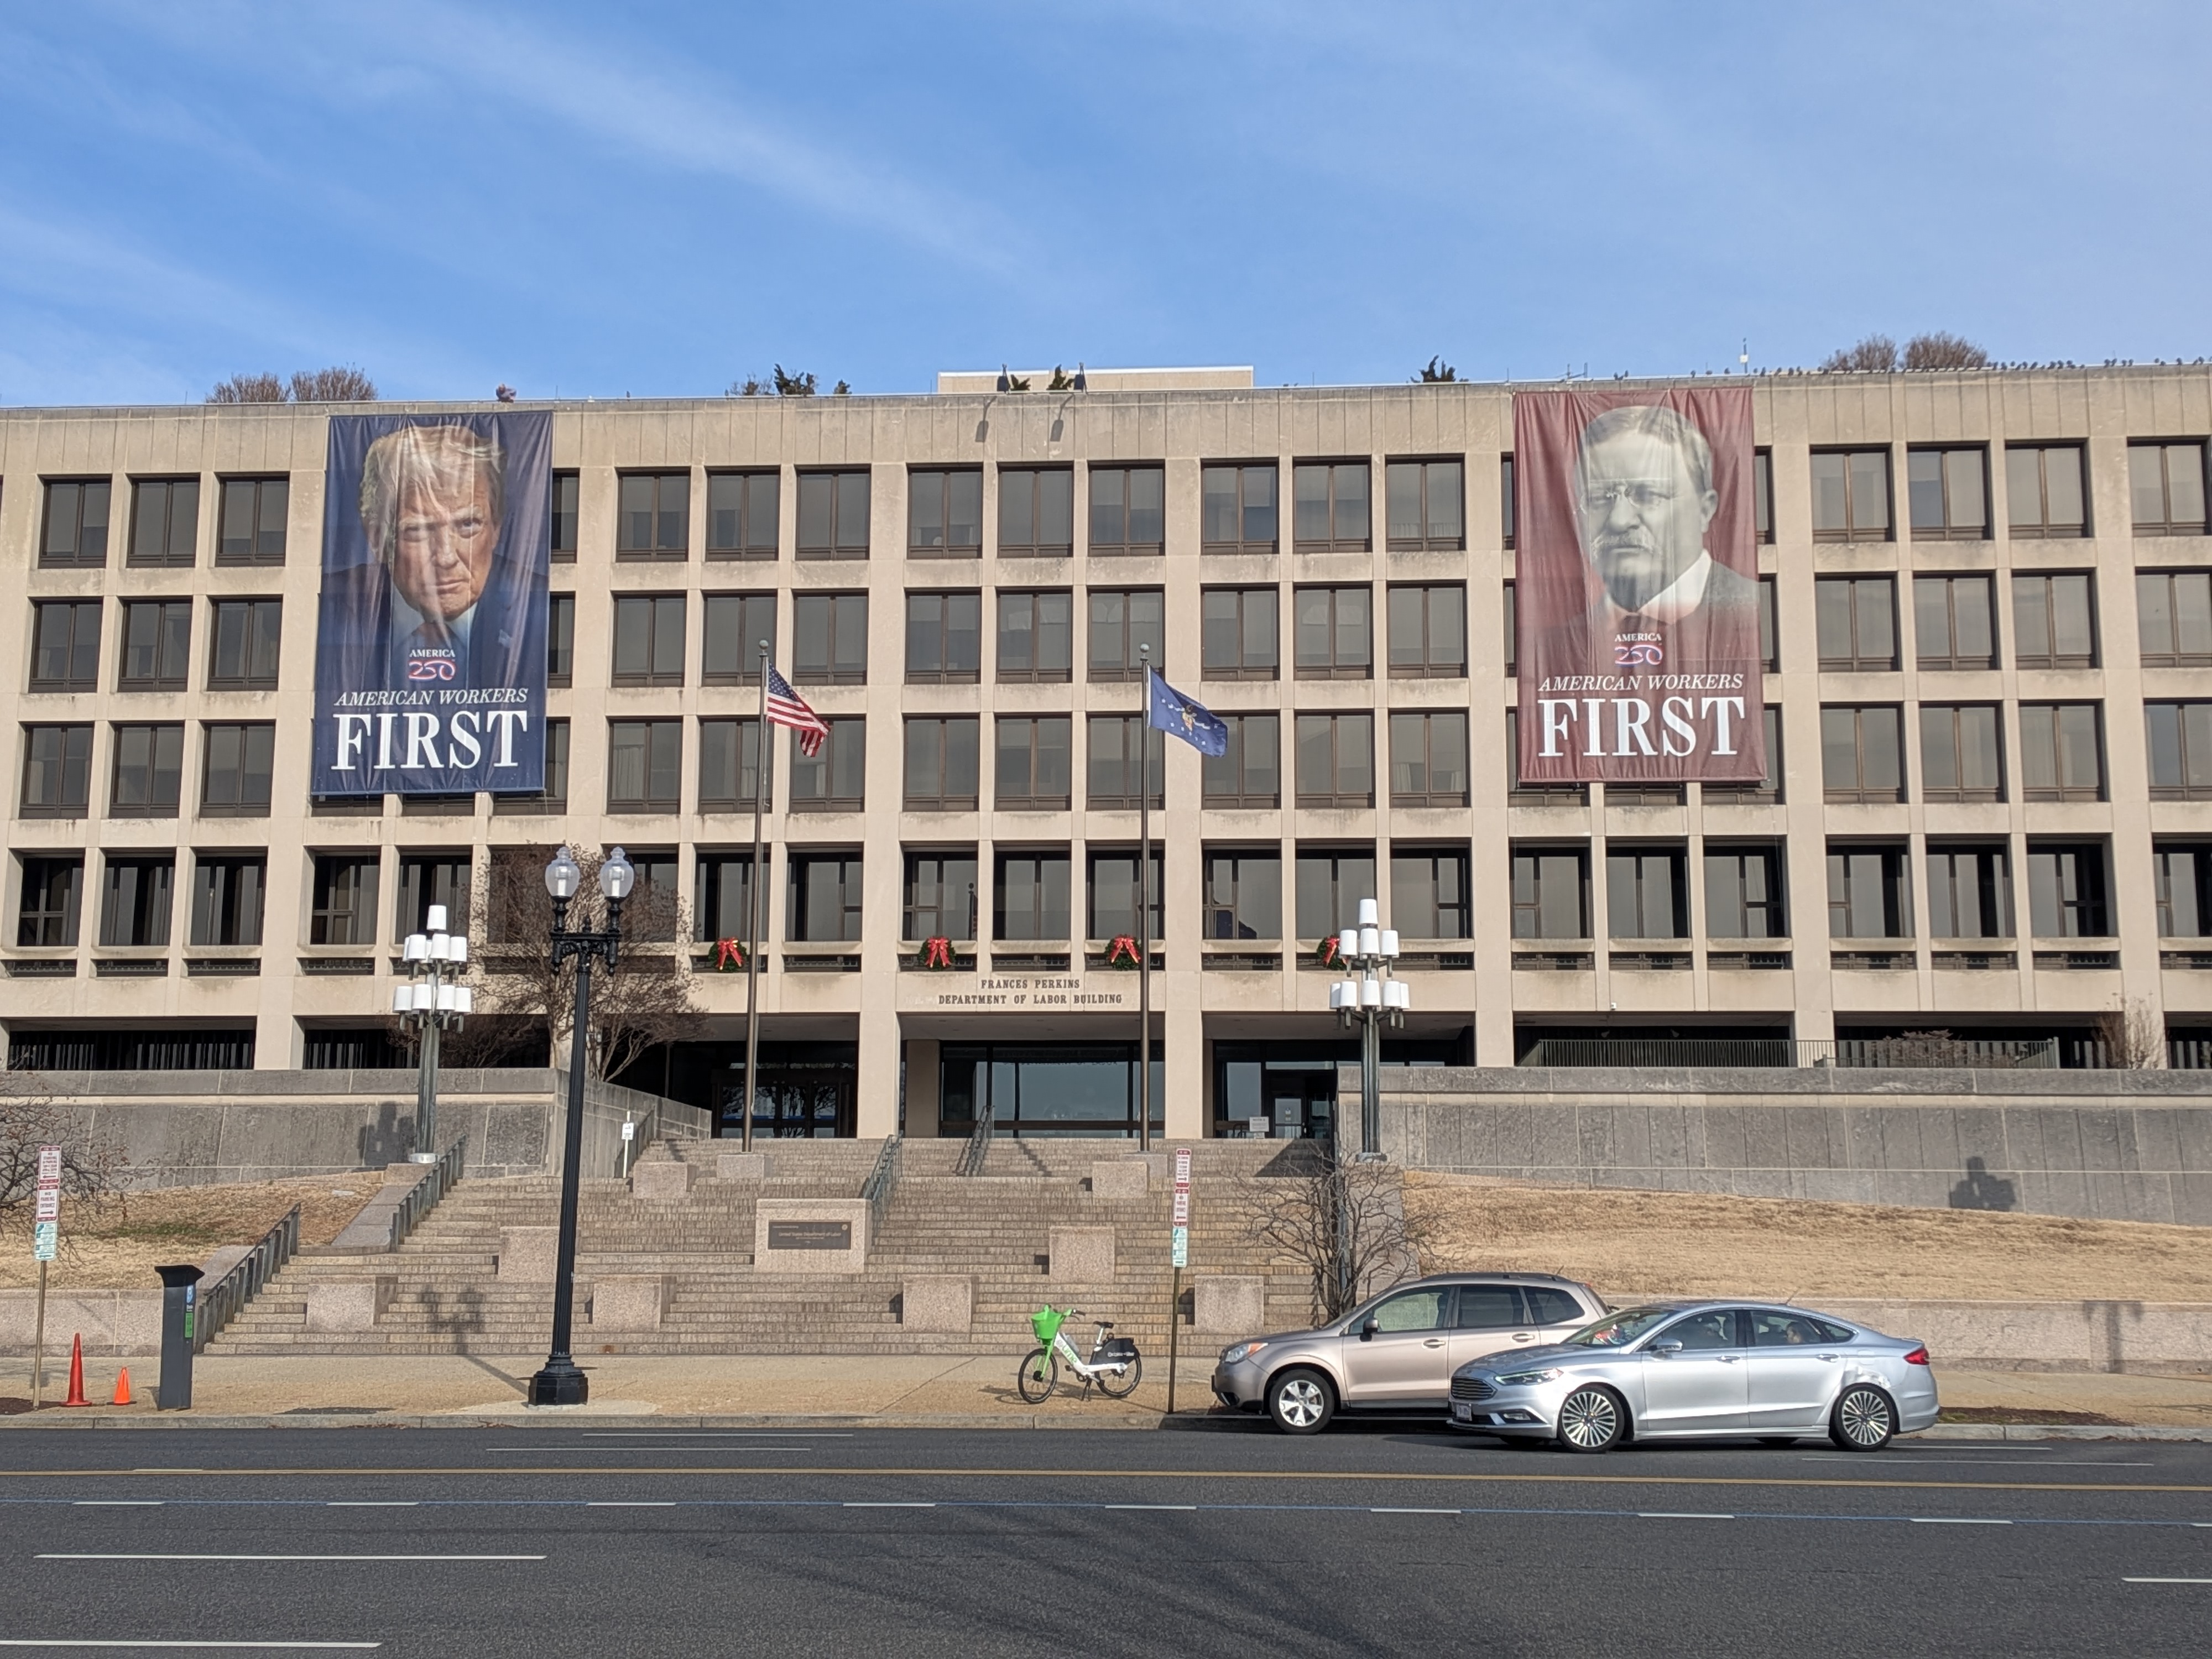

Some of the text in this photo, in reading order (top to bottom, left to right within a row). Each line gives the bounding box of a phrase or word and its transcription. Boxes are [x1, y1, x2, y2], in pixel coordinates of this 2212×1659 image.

[1615, 633, 1662, 642] AMERICA
[409, 649, 455, 658] AMERICA
[1614, 644, 1663, 667] 250
[408, 659, 456, 681] 250
[1537, 673, 1744, 692] AMERICAN WORKERS
[333, 687, 528, 707] AMERICAN WORKERS
[1537, 696, 1745, 757] FIRST
[331, 710, 528, 770] FIRST
[980, 979, 1080, 989] FRANCES PERKINS
[938, 994, 1122, 1004] DEPARTMENT OF LABOR BUILDING
